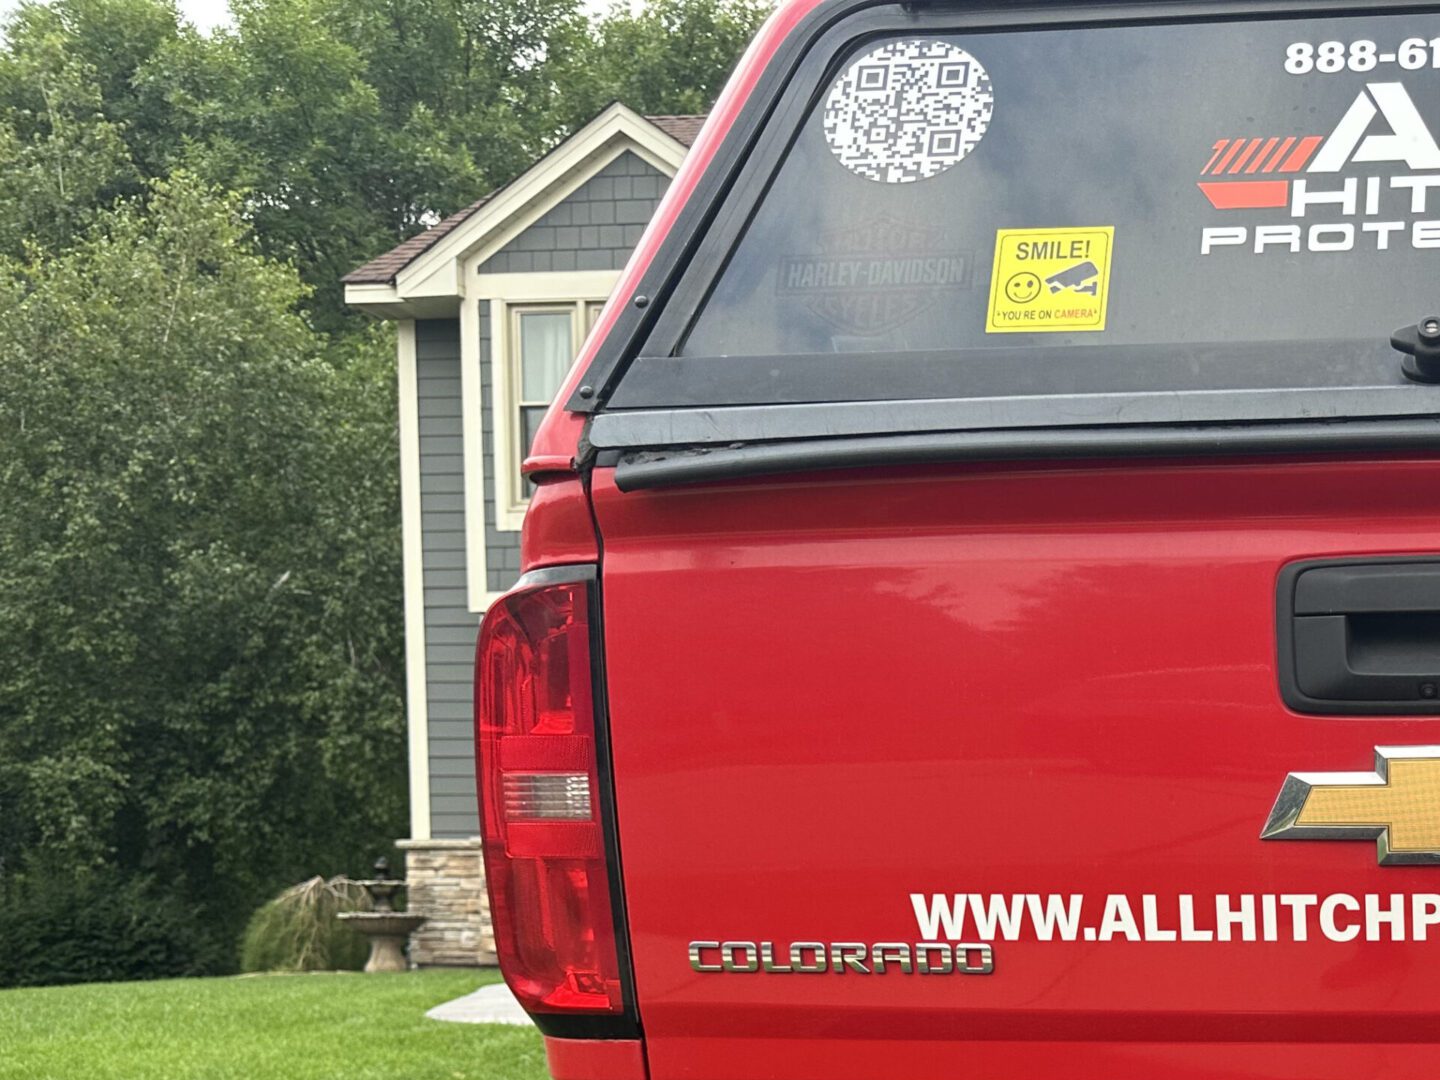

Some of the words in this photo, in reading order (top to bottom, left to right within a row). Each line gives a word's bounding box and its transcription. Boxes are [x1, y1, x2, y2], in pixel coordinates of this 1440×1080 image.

[1015, 240, 1091, 260] SMILE!
[787, 257, 964, 288] HARLEY-DAVIDSON
[1038, 310, 1052, 320] ON
[688, 941, 995, 975] COLORADO
